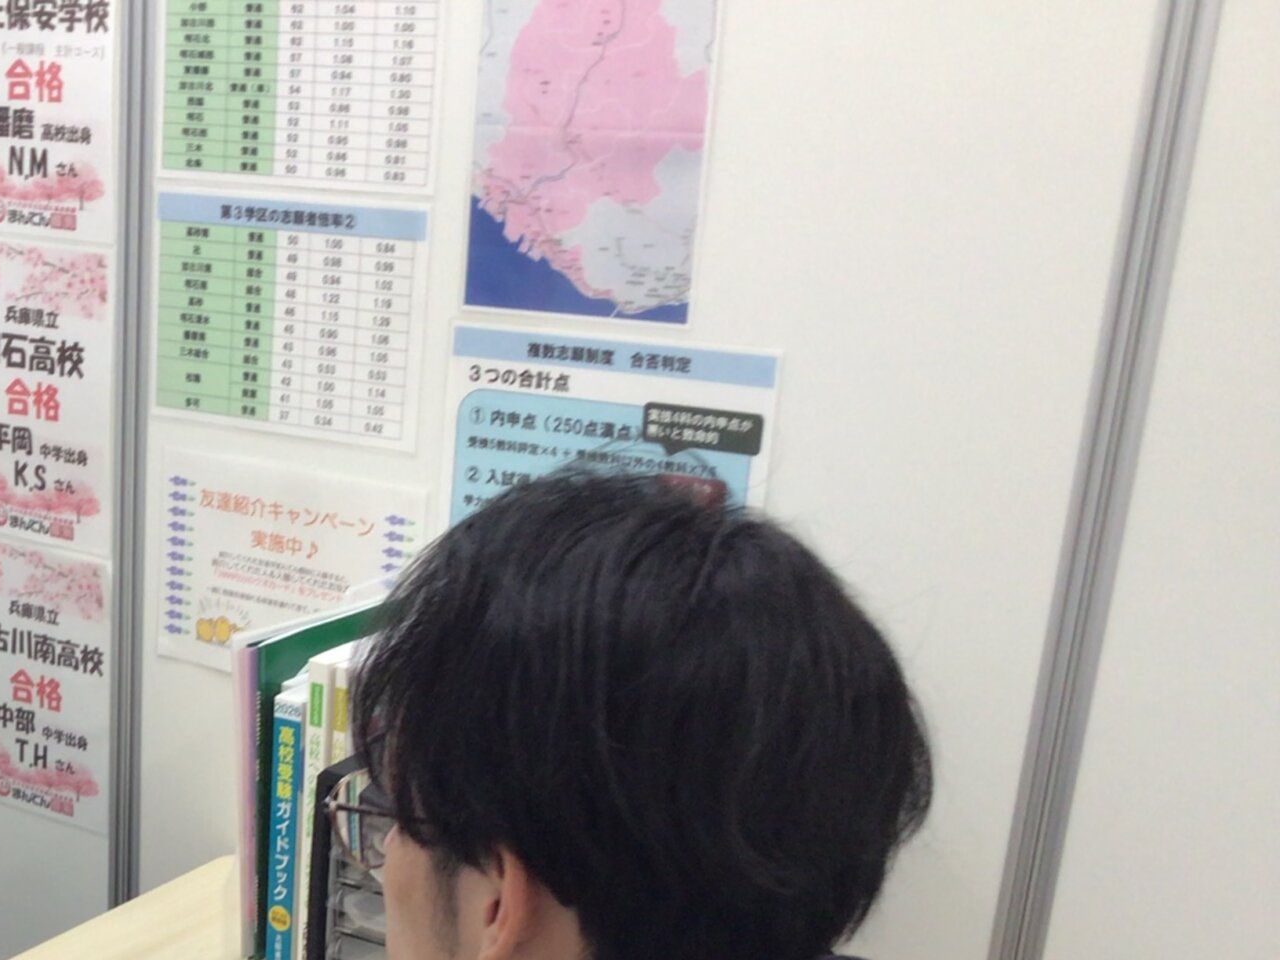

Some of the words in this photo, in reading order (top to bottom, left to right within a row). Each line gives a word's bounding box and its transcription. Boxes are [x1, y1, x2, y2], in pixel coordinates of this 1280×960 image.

[5, 59, 63, 102] 合格
[55, 161, 78, 178] さん
[630, 351, 692, 373] 合否判定
[5, 378, 60, 422] 合格
[199, 489, 376, 537] 友達紹介キャンペーン
[9, 668, 63, 713] 合格
[273, 726, 296, 901] 高校受験ガイドブック
